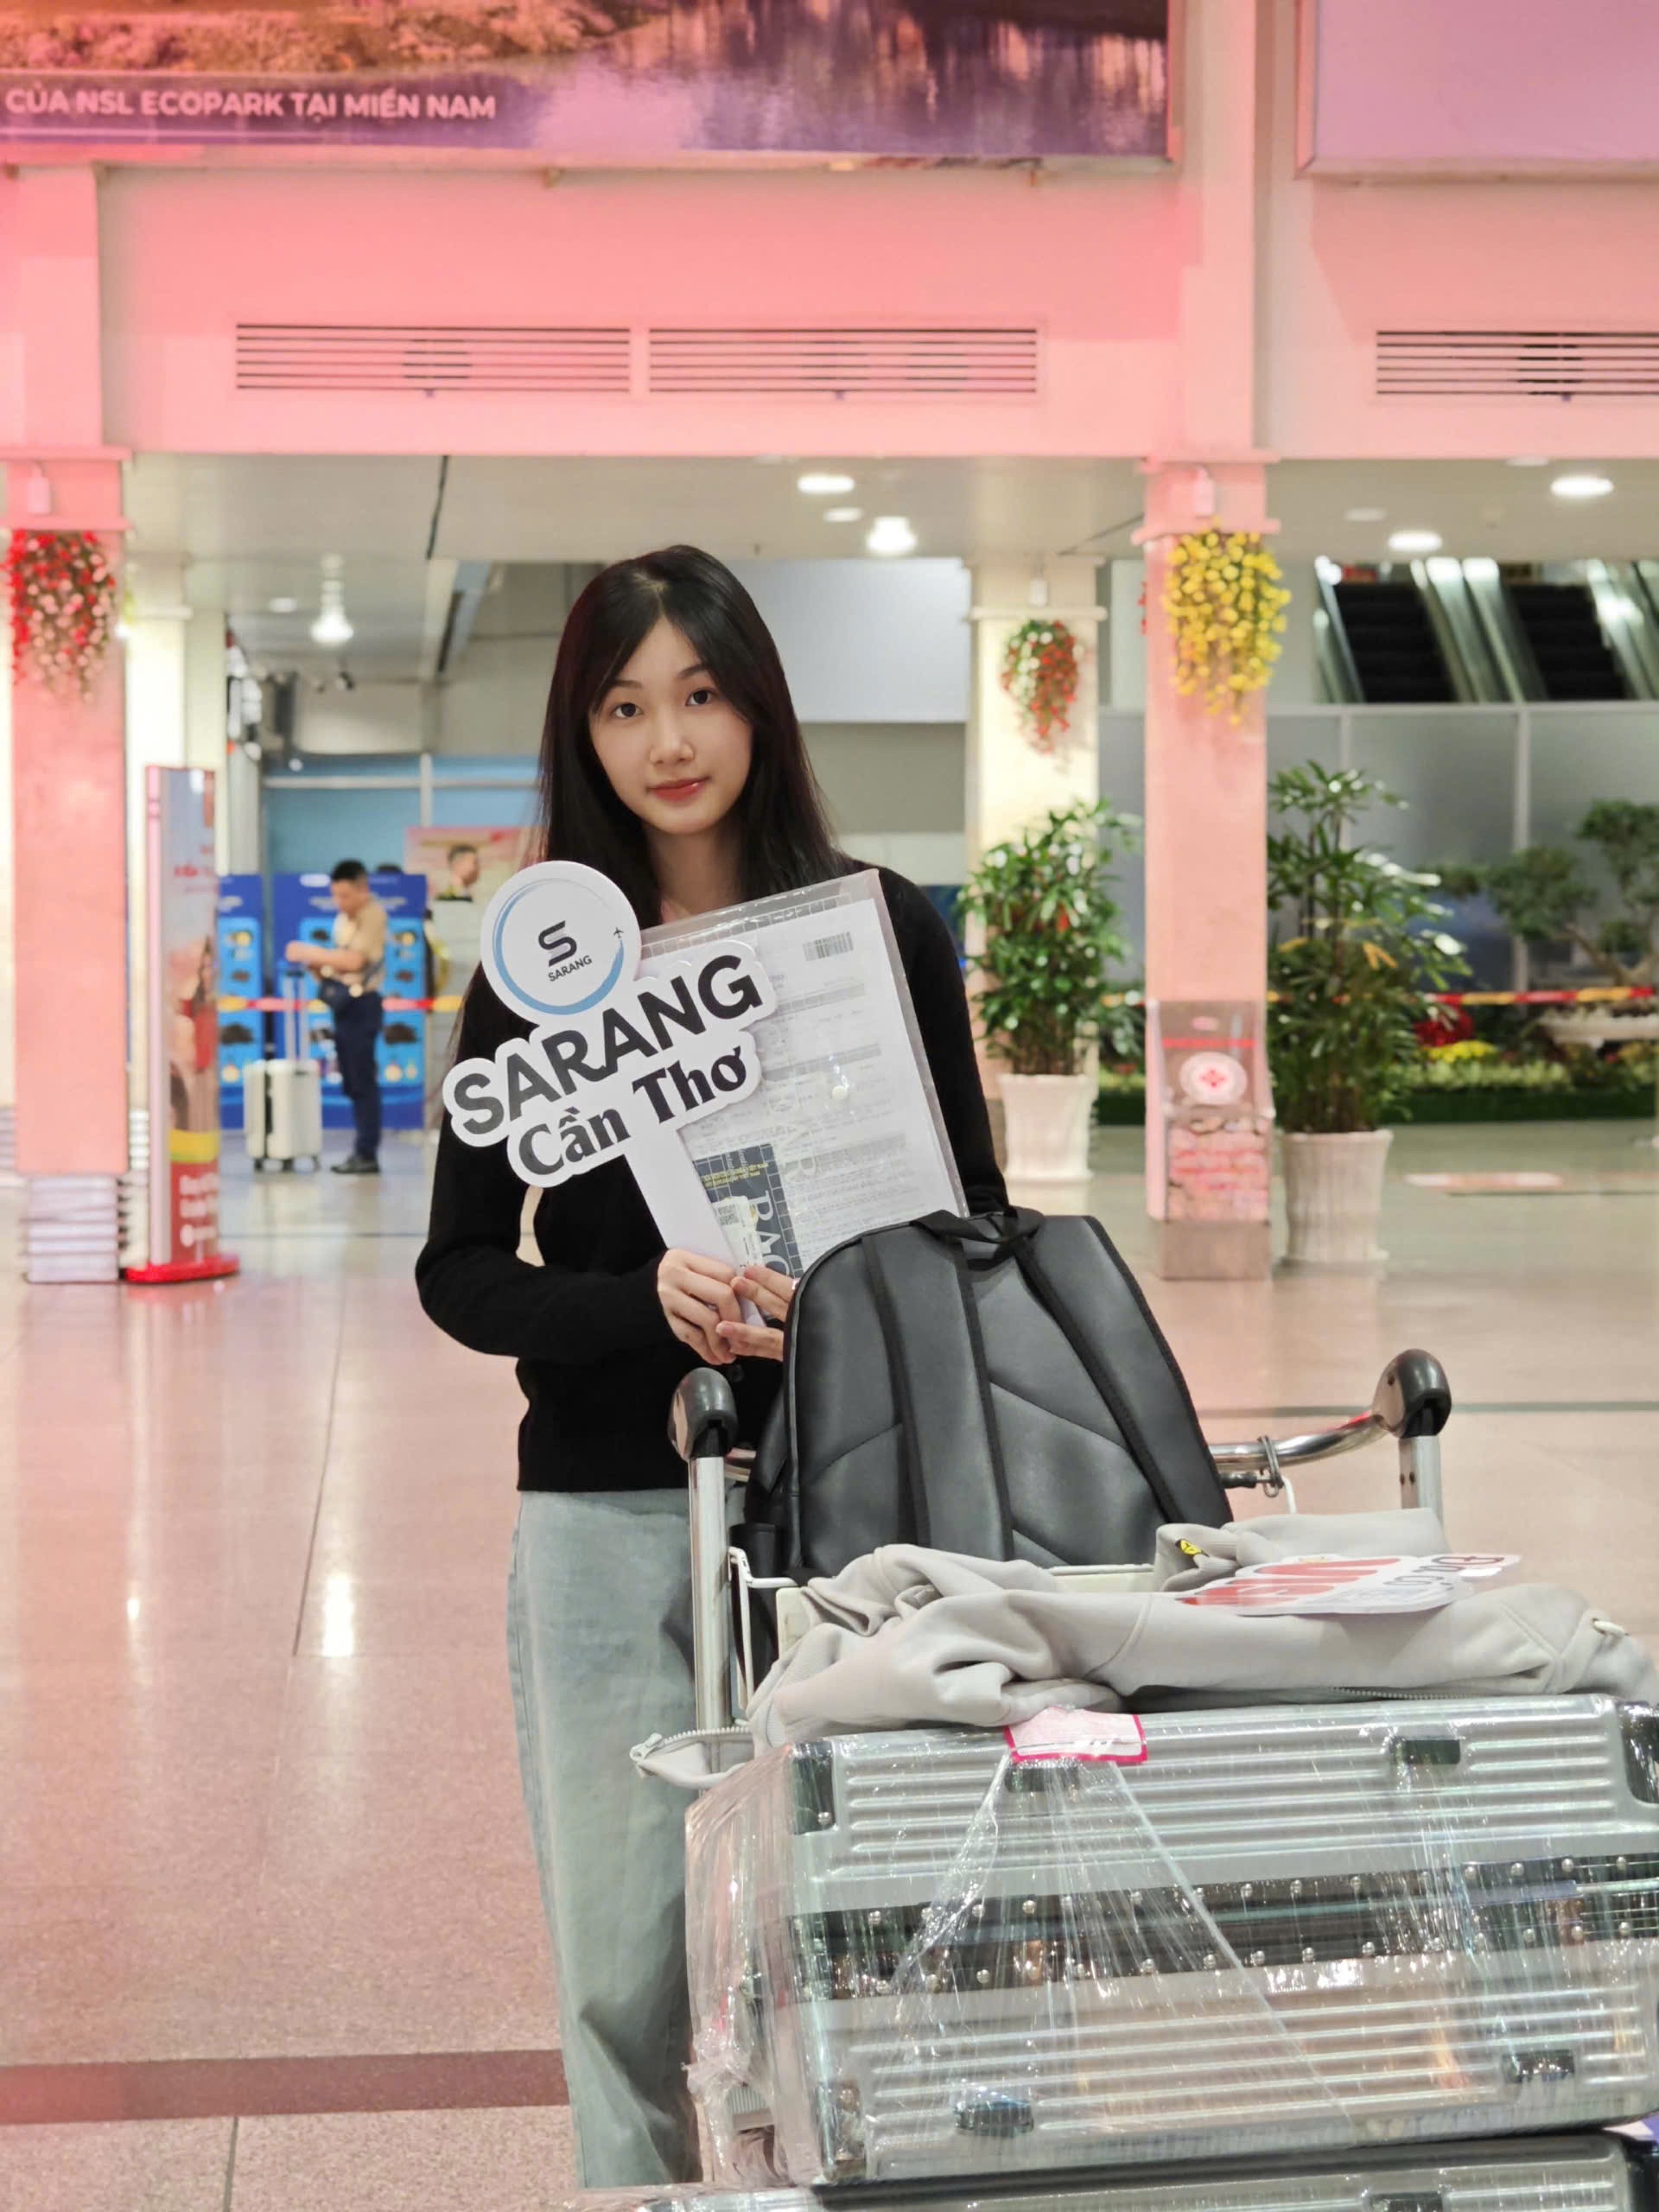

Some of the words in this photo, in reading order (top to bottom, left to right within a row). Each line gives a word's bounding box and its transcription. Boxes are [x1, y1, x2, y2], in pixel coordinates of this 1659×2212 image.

[75, 89, 134, 115] NSL
[140, 90, 284, 116] ECOPARK
[289, 92, 337, 124] TẠI
[426, 94, 497, 119] NAM
[548, 955, 593, 982] SARANG
[454, 954, 763, 1135] SARANG
[518, 1106, 631, 1175] Cần
[632, 1046, 747, 1124] Thơ
